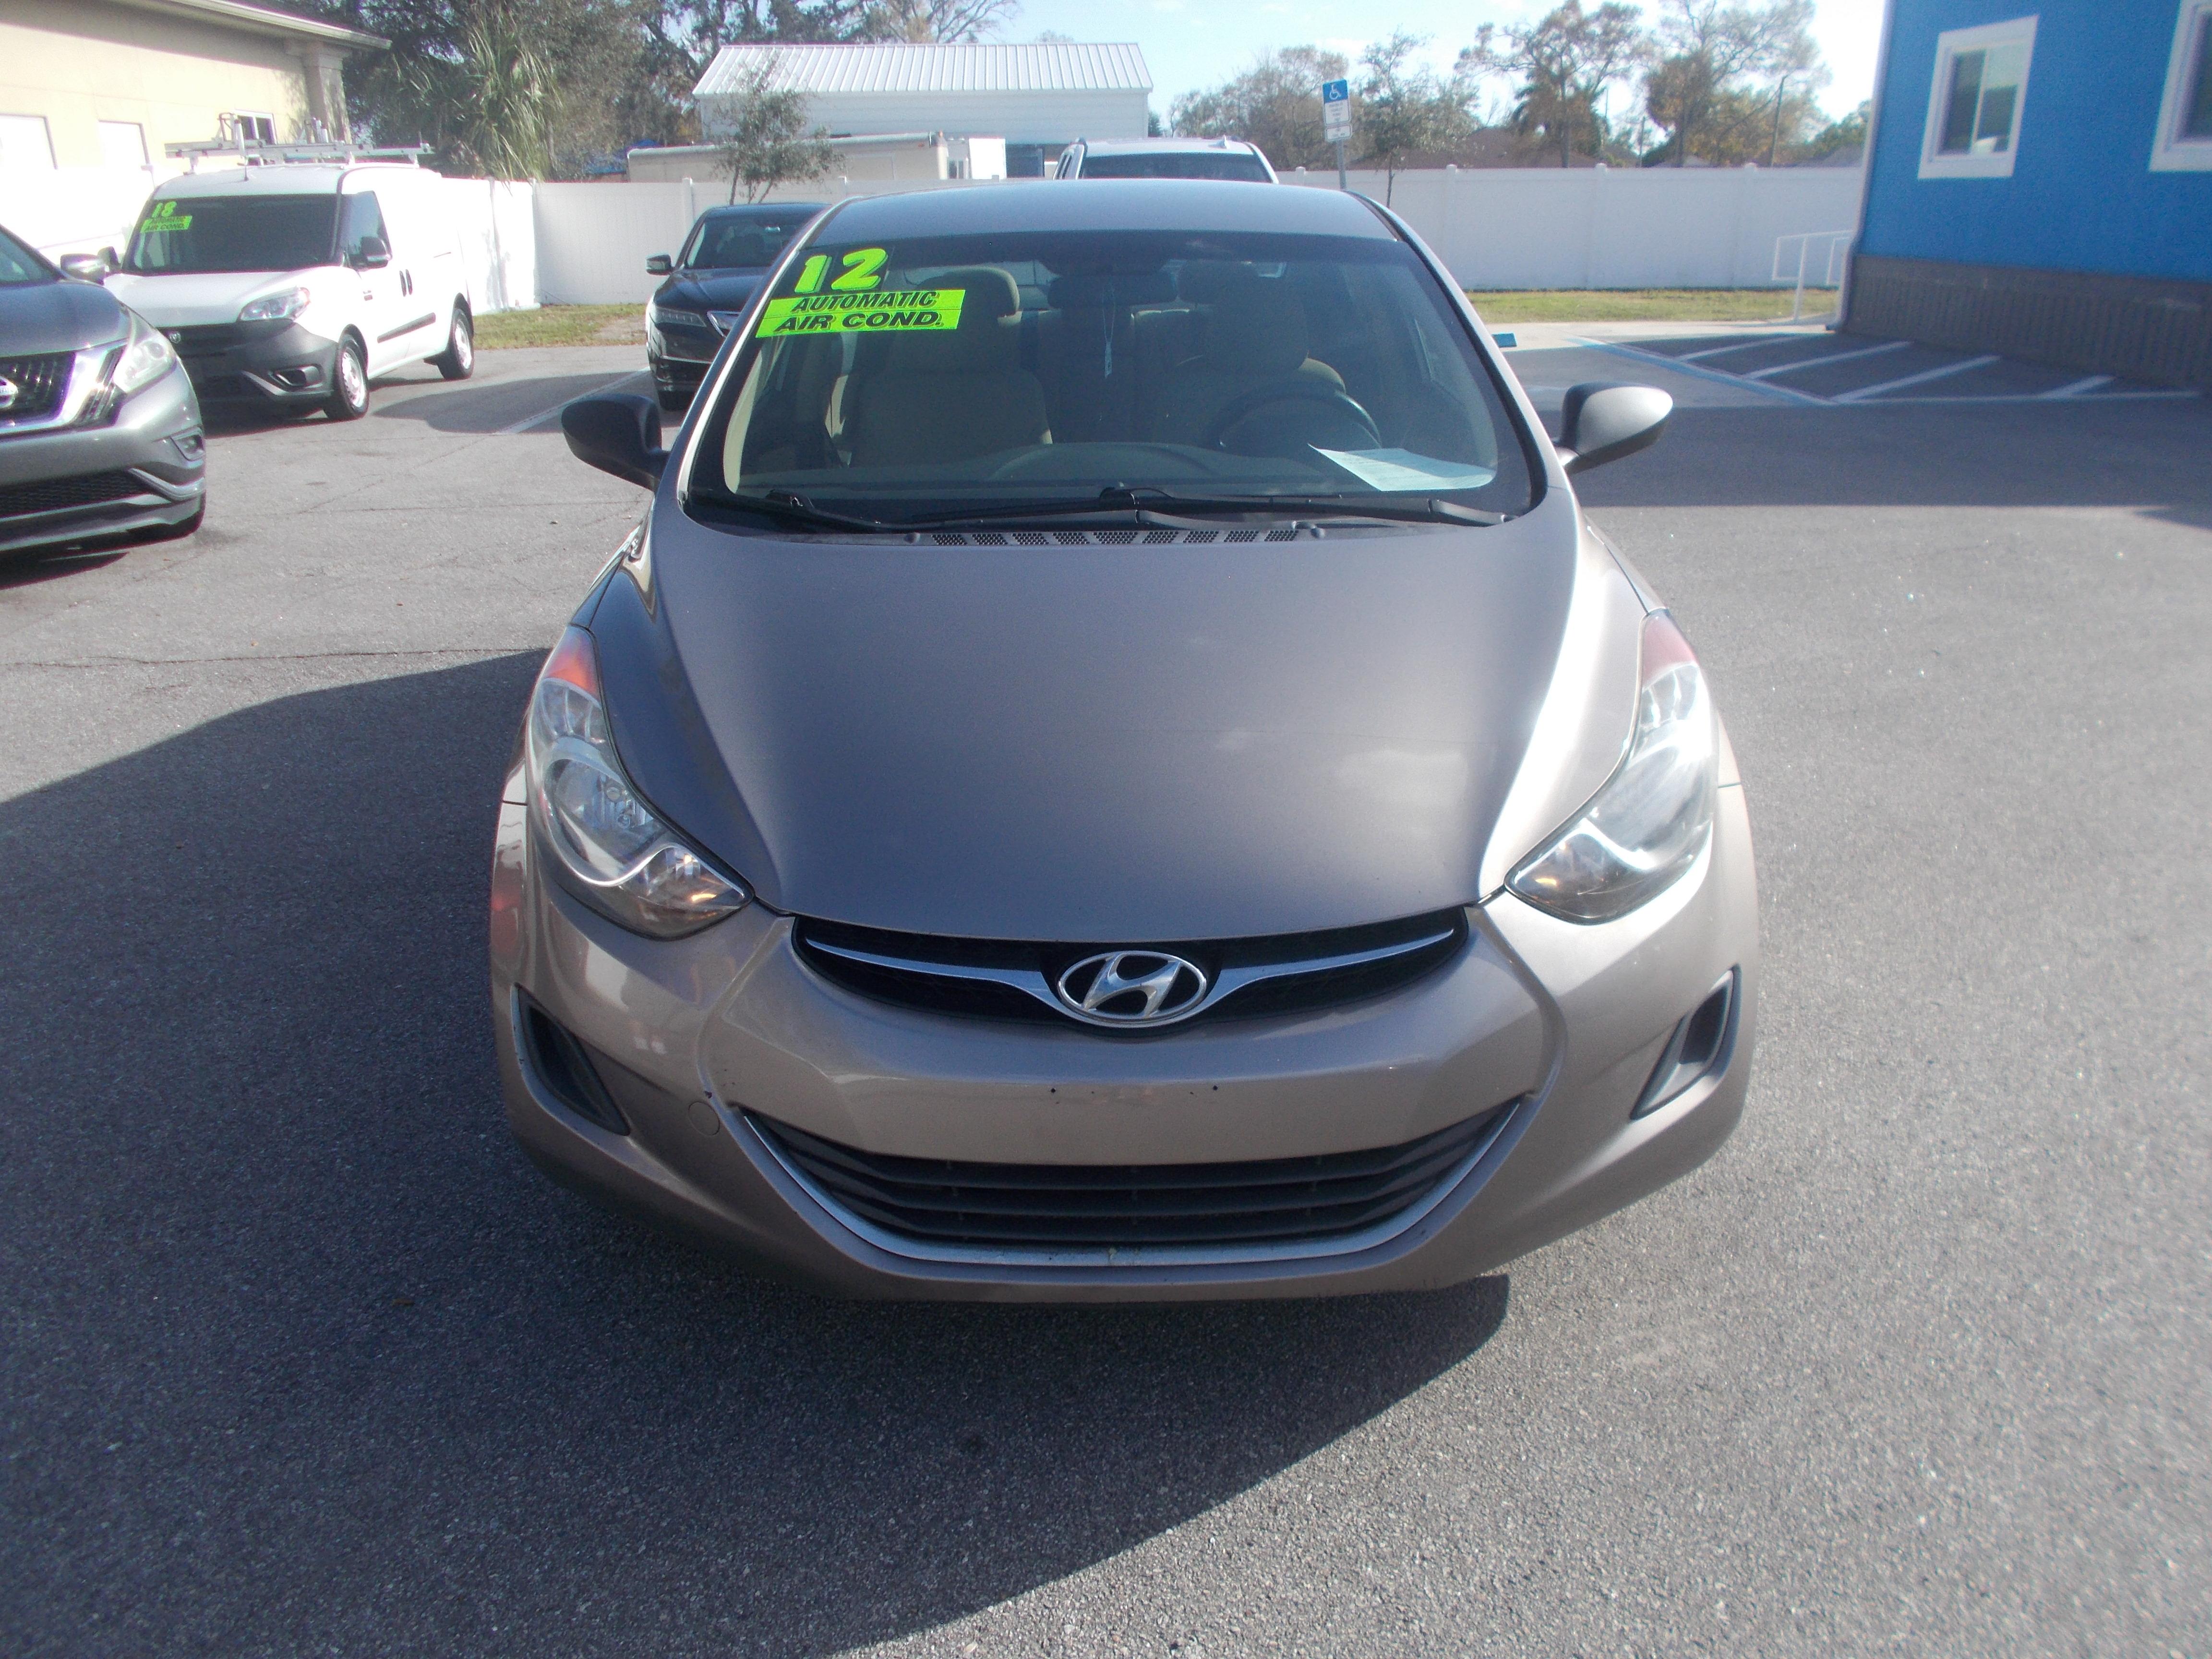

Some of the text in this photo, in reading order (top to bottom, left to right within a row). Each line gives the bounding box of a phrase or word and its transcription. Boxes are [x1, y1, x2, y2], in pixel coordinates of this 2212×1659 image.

[794, 248, 888, 293] 12
[792, 291, 940, 313] AUTOMATIC
[773, 311, 943, 333] AIR COND.
